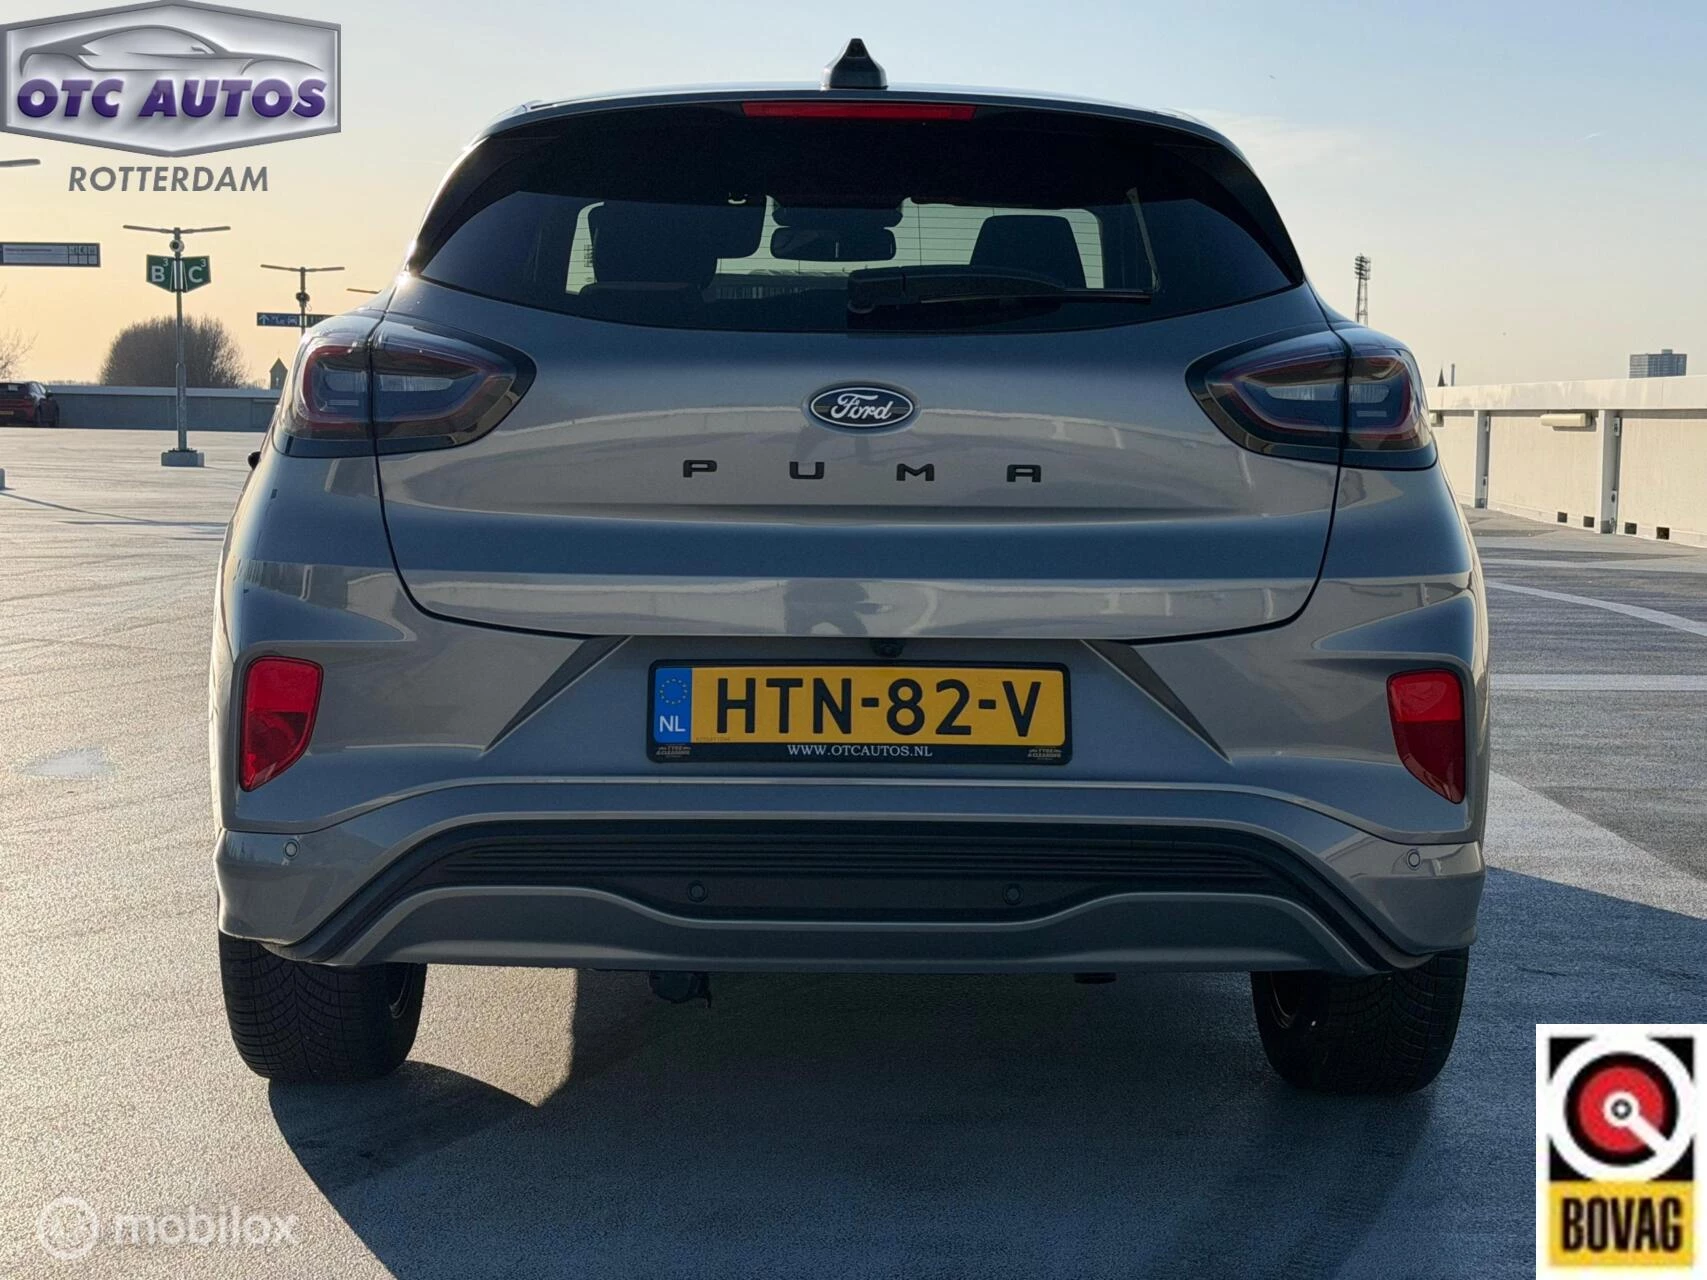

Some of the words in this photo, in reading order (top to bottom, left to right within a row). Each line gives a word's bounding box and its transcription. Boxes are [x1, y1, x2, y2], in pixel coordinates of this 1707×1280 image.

[830, 393, 893, 420] Ford
[683, 459, 1042, 483] PUMA
[716, 677, 1042, 737] HTN-82-V
[659, 715, 686, 732] NL
[787, 744, 933, 757] WWW.OTCAUTOS.NL
